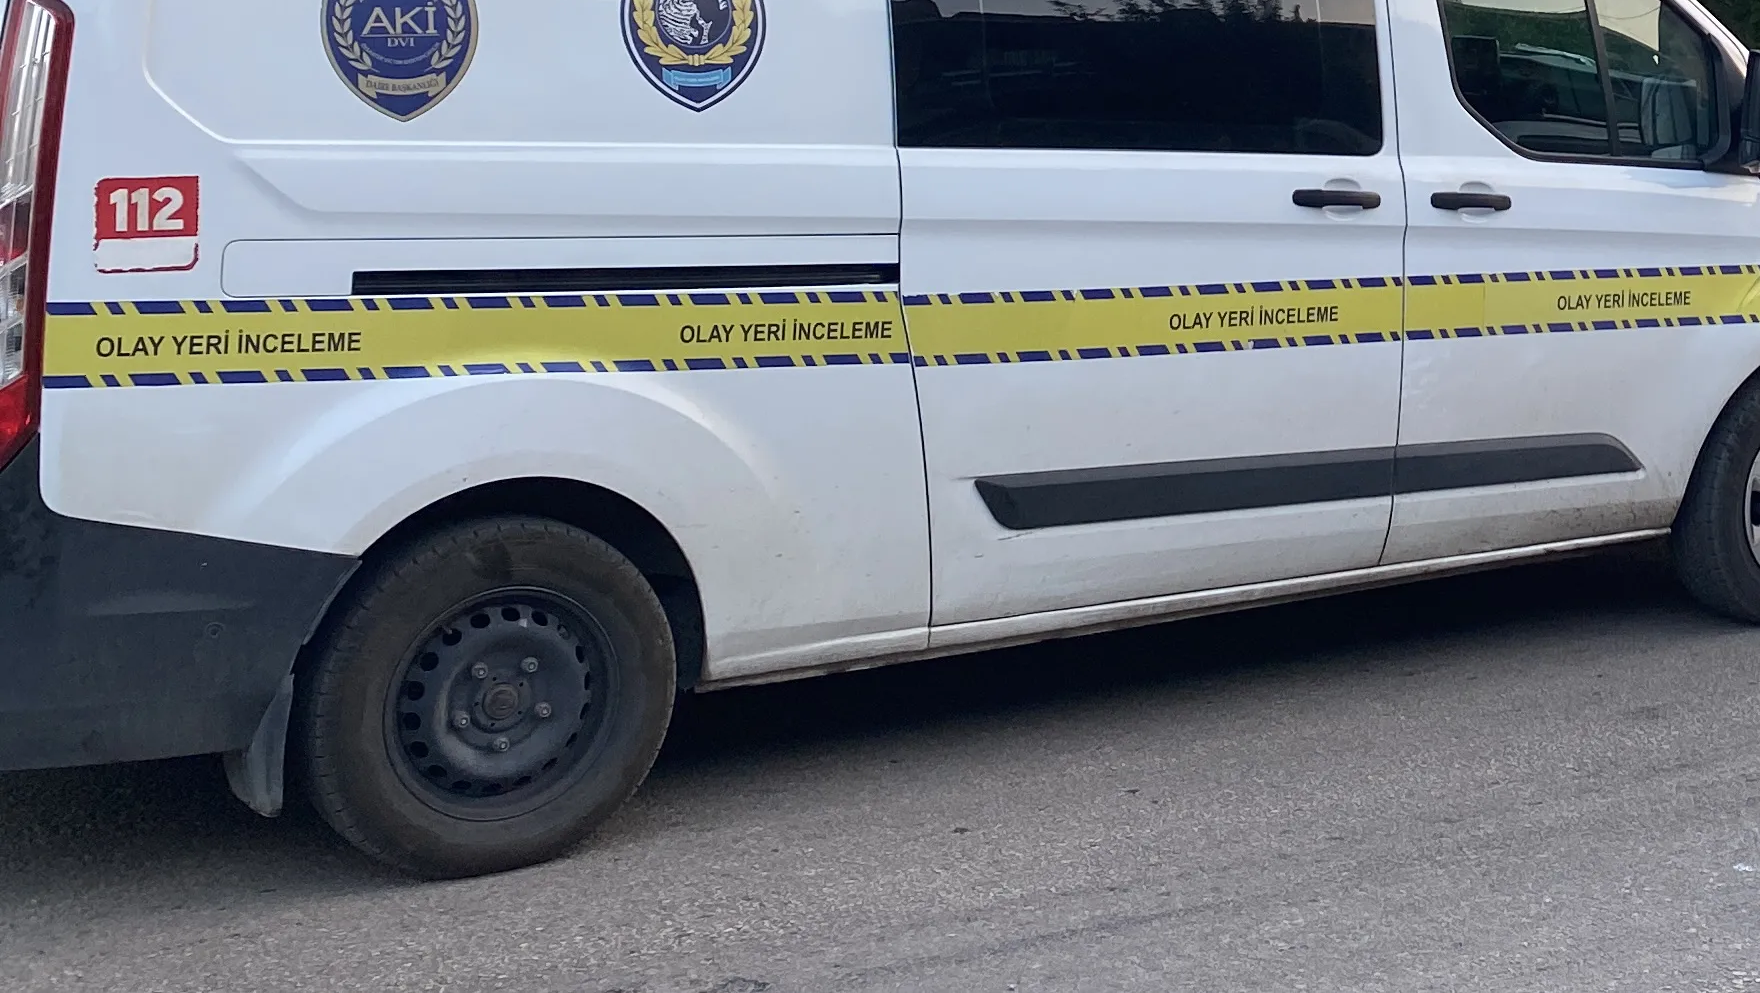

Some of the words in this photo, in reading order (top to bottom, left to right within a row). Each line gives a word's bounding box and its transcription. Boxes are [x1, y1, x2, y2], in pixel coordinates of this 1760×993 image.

[361, 1, 438, 35] AKİ
[387, 37, 415, 47] DVI
[109, 187, 184, 232] 112
[1557, 294, 1592, 311] OLAY
[1595, 289, 1625, 309] YERİ
[1628, 289, 1691, 308] İNCELEME
[1169, 311, 1213, 331] OLAY
[1218, 306, 1255, 328] YERİ
[1259, 305, 1338, 326] İNCELEME
[96, 335, 165, 358] OLAY
[172, 329, 230, 355] YERİ
[238, 329, 362, 354] İNCELEME
[679, 324, 734, 344] OLAY
[740, 319, 787, 342] YERİ
[793, 319, 893, 341] İNCELEME
